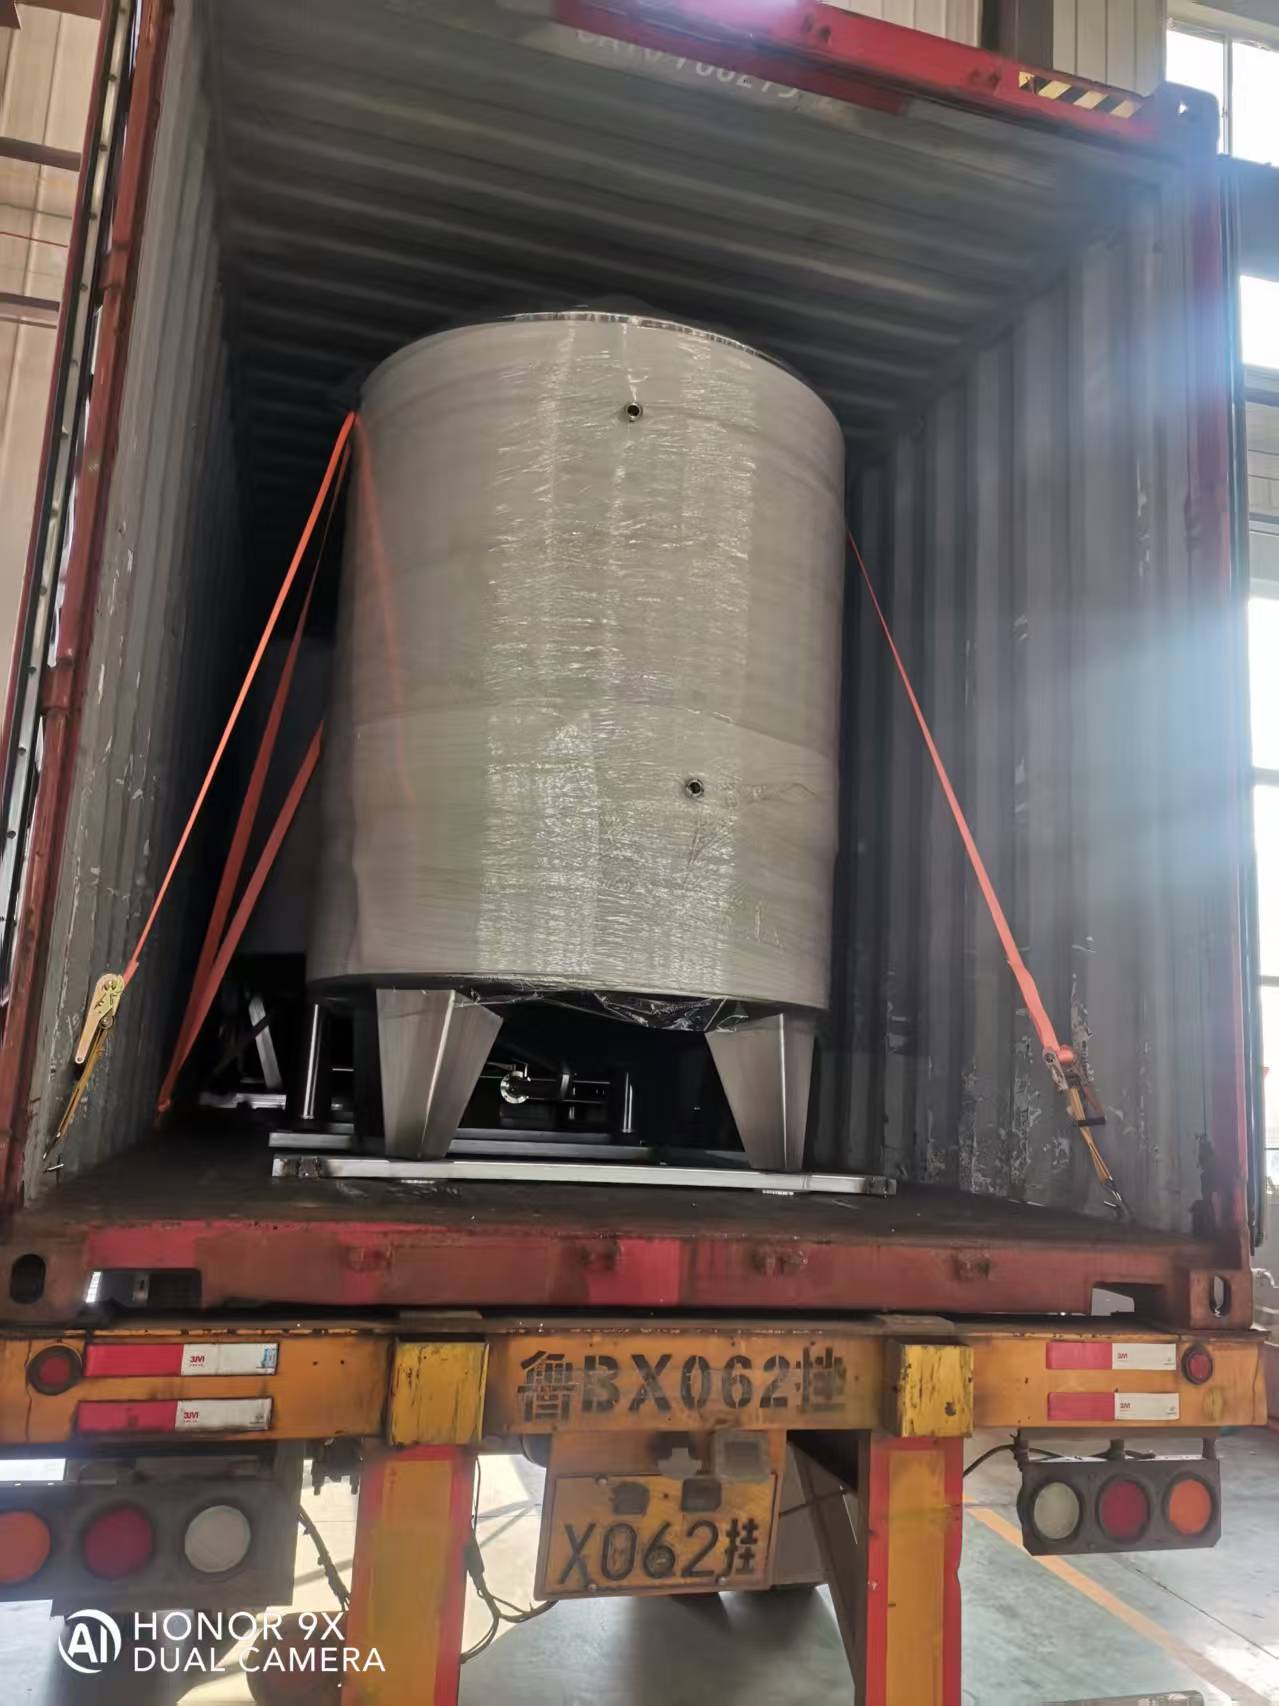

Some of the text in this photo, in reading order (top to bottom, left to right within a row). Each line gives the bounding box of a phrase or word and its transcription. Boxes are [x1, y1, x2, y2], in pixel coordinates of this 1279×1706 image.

[189, 1355, 205, 1364] 3M
[1117, 1352, 1129, 1360] 3M
[1119, 1402, 1131, 1410] 3M
[183, 1411, 199, 1420] 3M
[558, 1517, 760, 1585] X062挂
